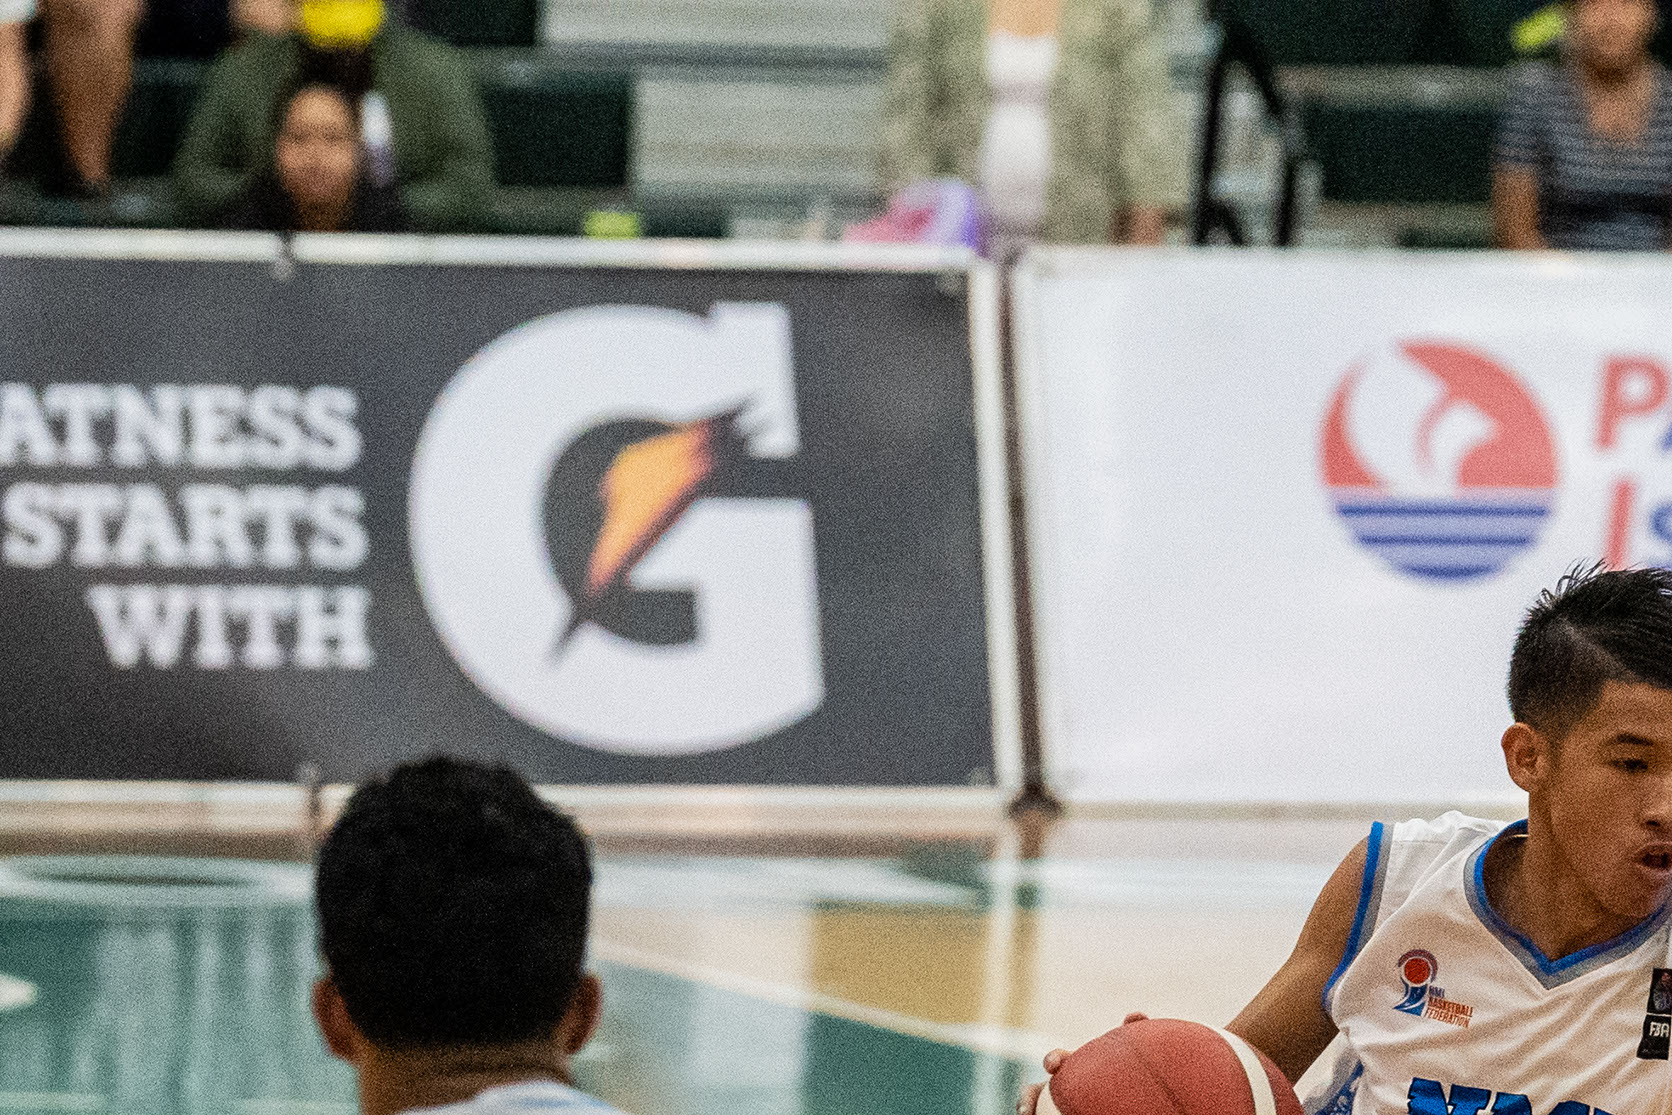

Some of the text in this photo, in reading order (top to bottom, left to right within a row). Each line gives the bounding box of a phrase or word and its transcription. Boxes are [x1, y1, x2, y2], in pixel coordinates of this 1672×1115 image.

[0, 382, 361, 470] ATNESS
[3, 482, 369, 569] STARTS
[87, 584, 374, 670] WITH
[1428, 997, 1474, 1018] BASKETBALL
[1428, 1008, 1470, 1028] FEDERATION
